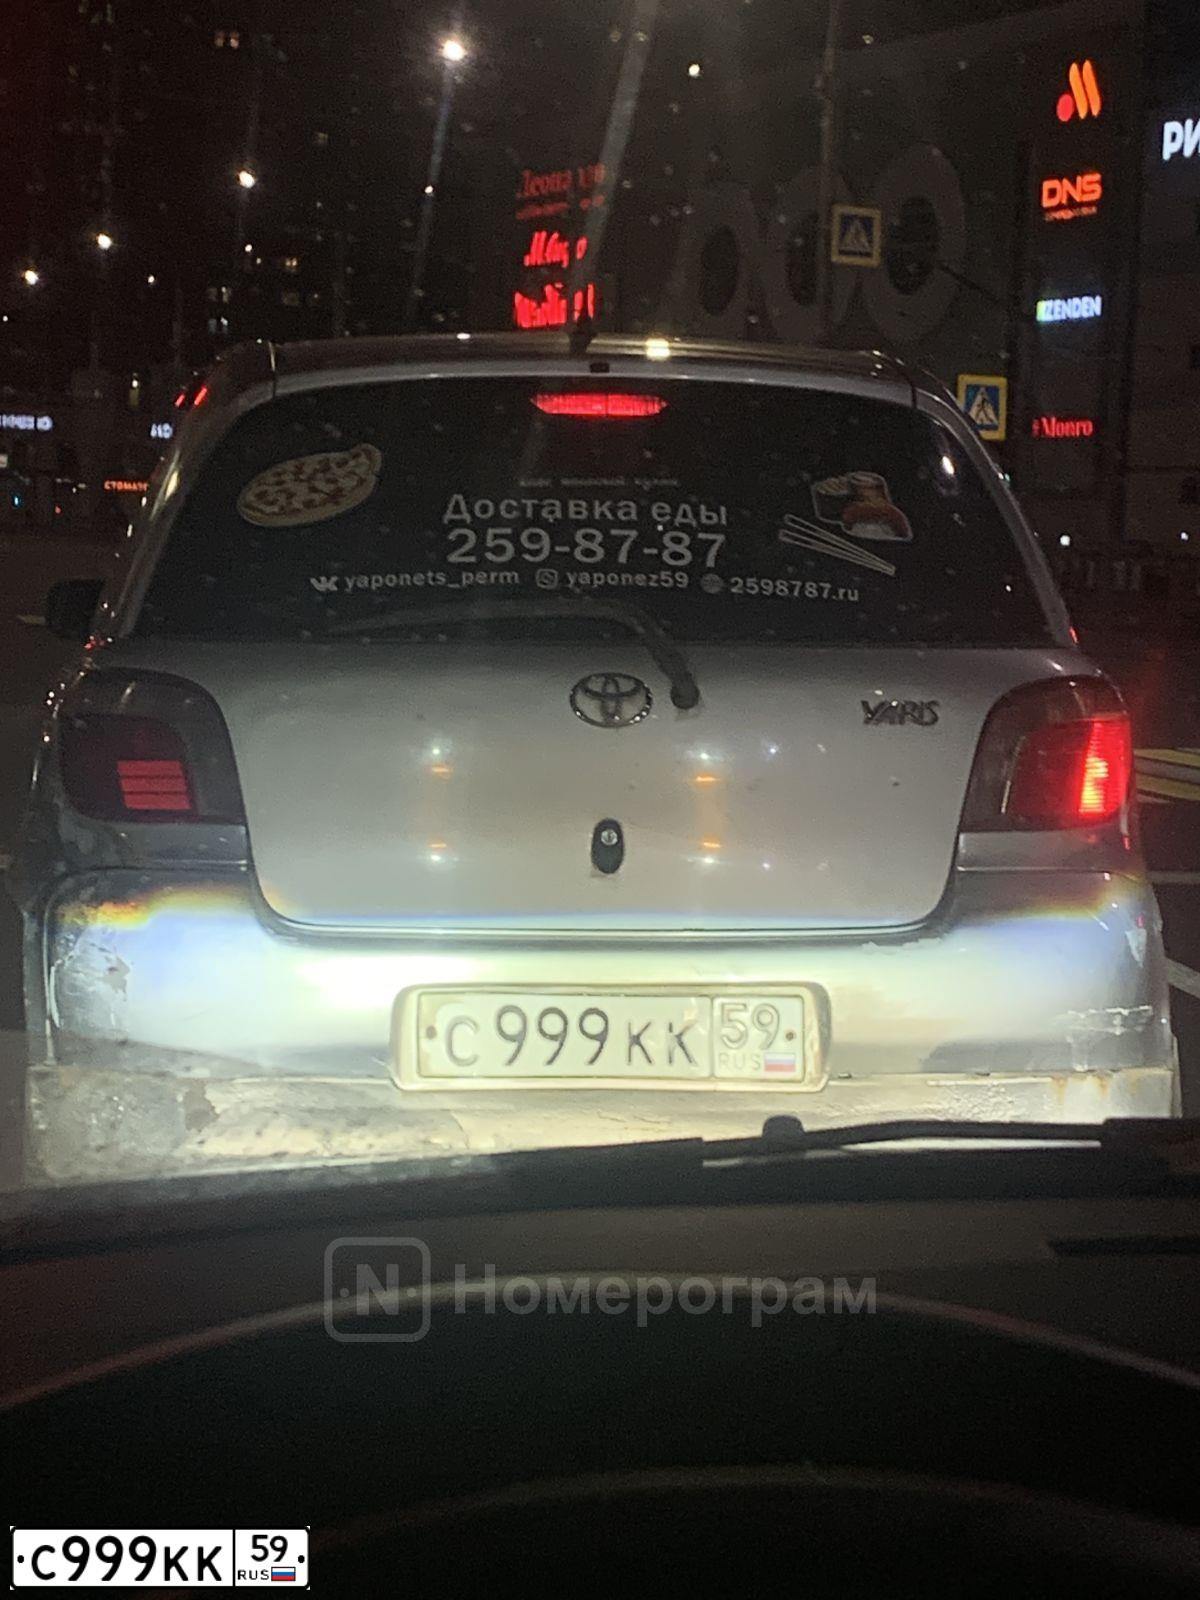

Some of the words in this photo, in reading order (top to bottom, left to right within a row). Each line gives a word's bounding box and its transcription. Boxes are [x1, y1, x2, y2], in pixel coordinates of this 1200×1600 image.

[1041, 172, 1102, 208] DNS
[1040, 295, 1102, 321] ZENDEN
[442, 494, 638, 524] Доставка
[651, 501, 728, 528] еды
[446, 527, 727, 568] 259-87-87
[344, 569, 520, 592] yaponets_perm
[566, 570, 690, 590] yaponez59
[730, 576, 860, 601] 2598787.ru
[861, 700, 939, 726] YARIS
[719, 1003, 781, 1050] 59
[718, 1052, 762, 1072] RUS
